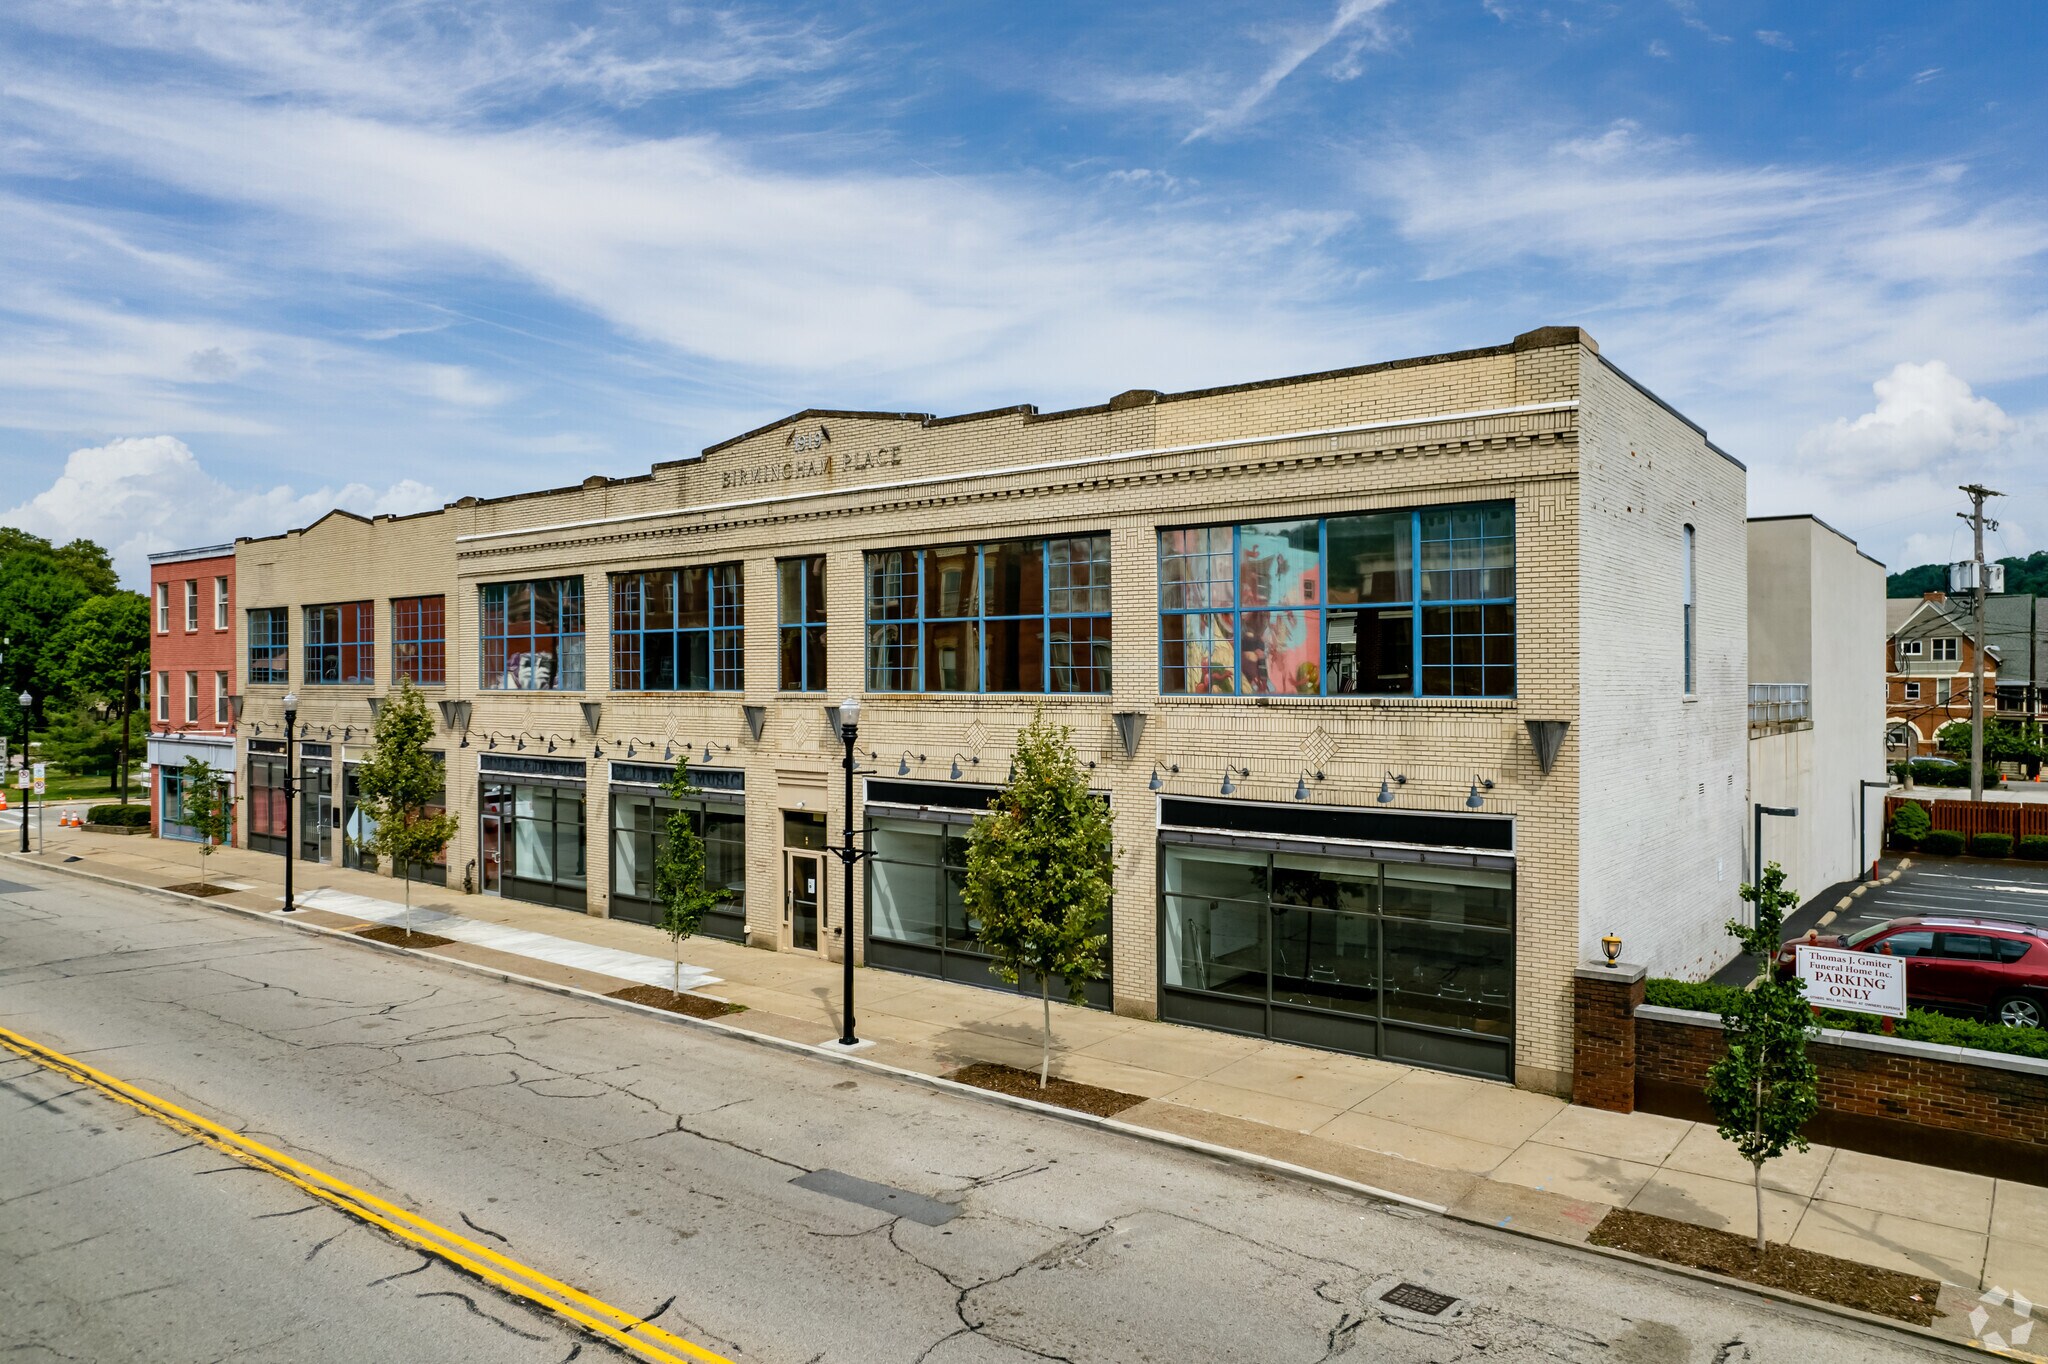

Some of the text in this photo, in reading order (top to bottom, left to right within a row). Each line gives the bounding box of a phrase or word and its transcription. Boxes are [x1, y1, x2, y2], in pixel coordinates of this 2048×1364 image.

[794, 432, 822, 452] 1919
[722, 447, 901, 488] BIRMINGHAM PLACE
[695, 771, 740, 788] MUSIC
[1809, 952, 1892, 969] Thomas J. Gmiter
[1809, 961, 1893, 979] Funeral Home Inc.
[1815, 971, 1886, 990] PARKING
[1829, 986, 1872, 1001] ONLY
